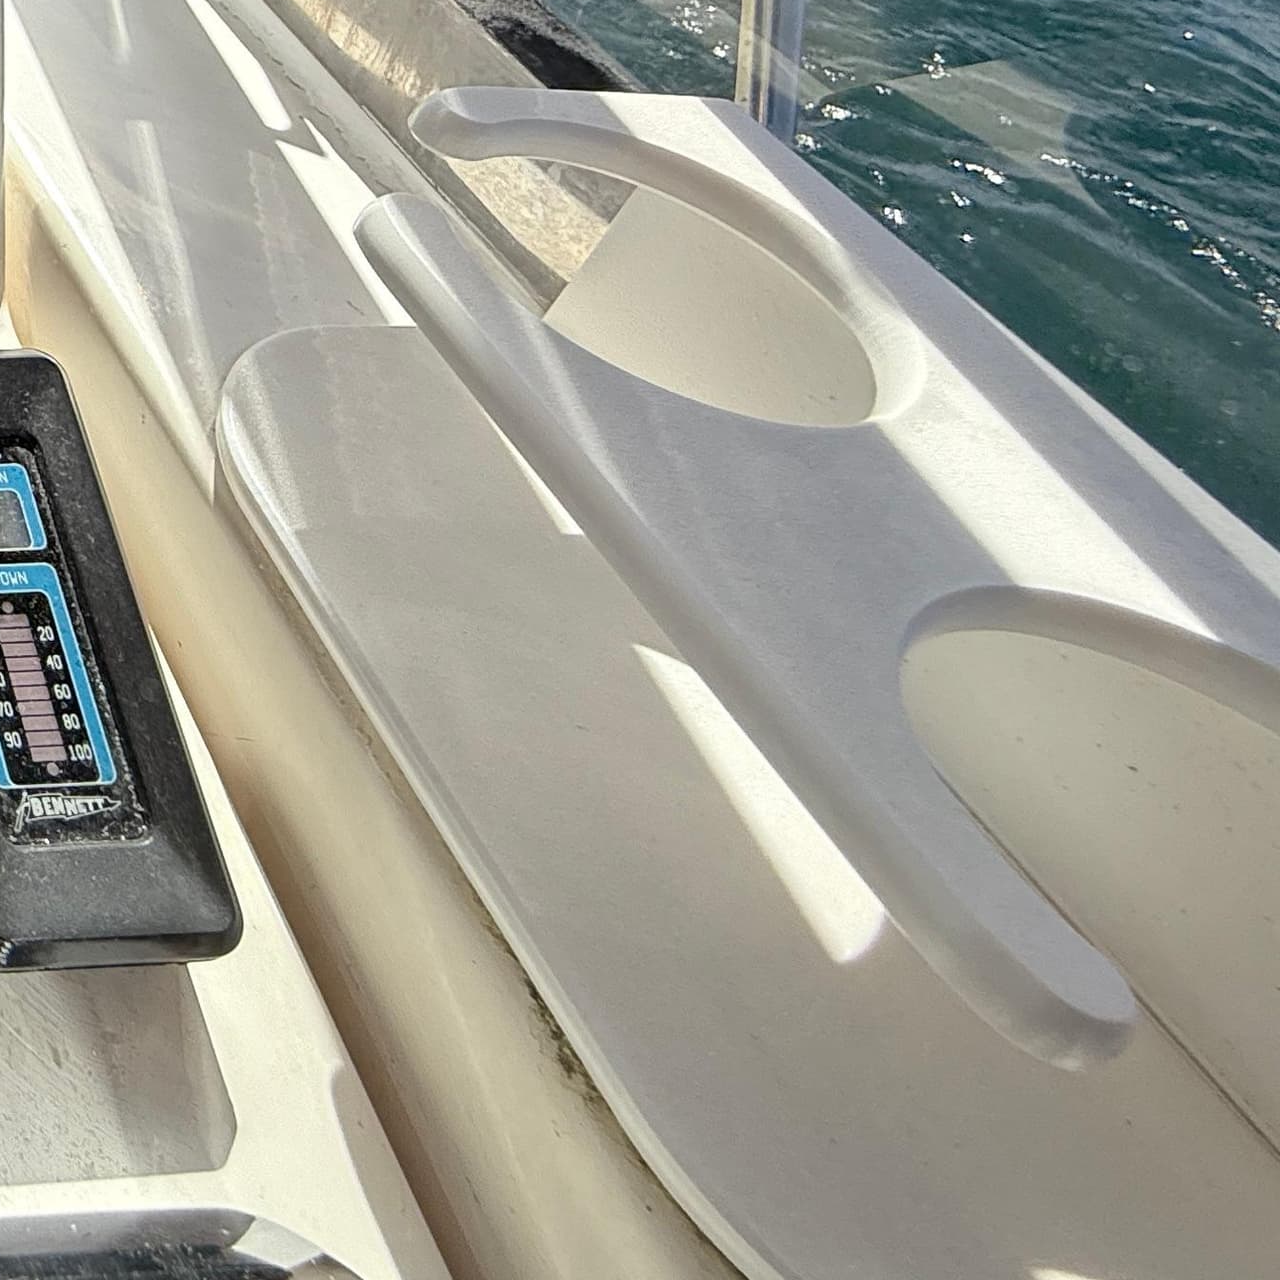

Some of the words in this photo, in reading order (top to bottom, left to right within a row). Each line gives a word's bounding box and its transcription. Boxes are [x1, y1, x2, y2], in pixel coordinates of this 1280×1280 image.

[38, 626, 54, 641] 20
[46, 655, 63, 670] 40
[54, 684, 71, 700] 60
[62, 714, 80, 730] 80
[4, 731, 21, 749] 90
[68, 744, 92, 761] 100
[29, 794, 108, 818] BENNETT
